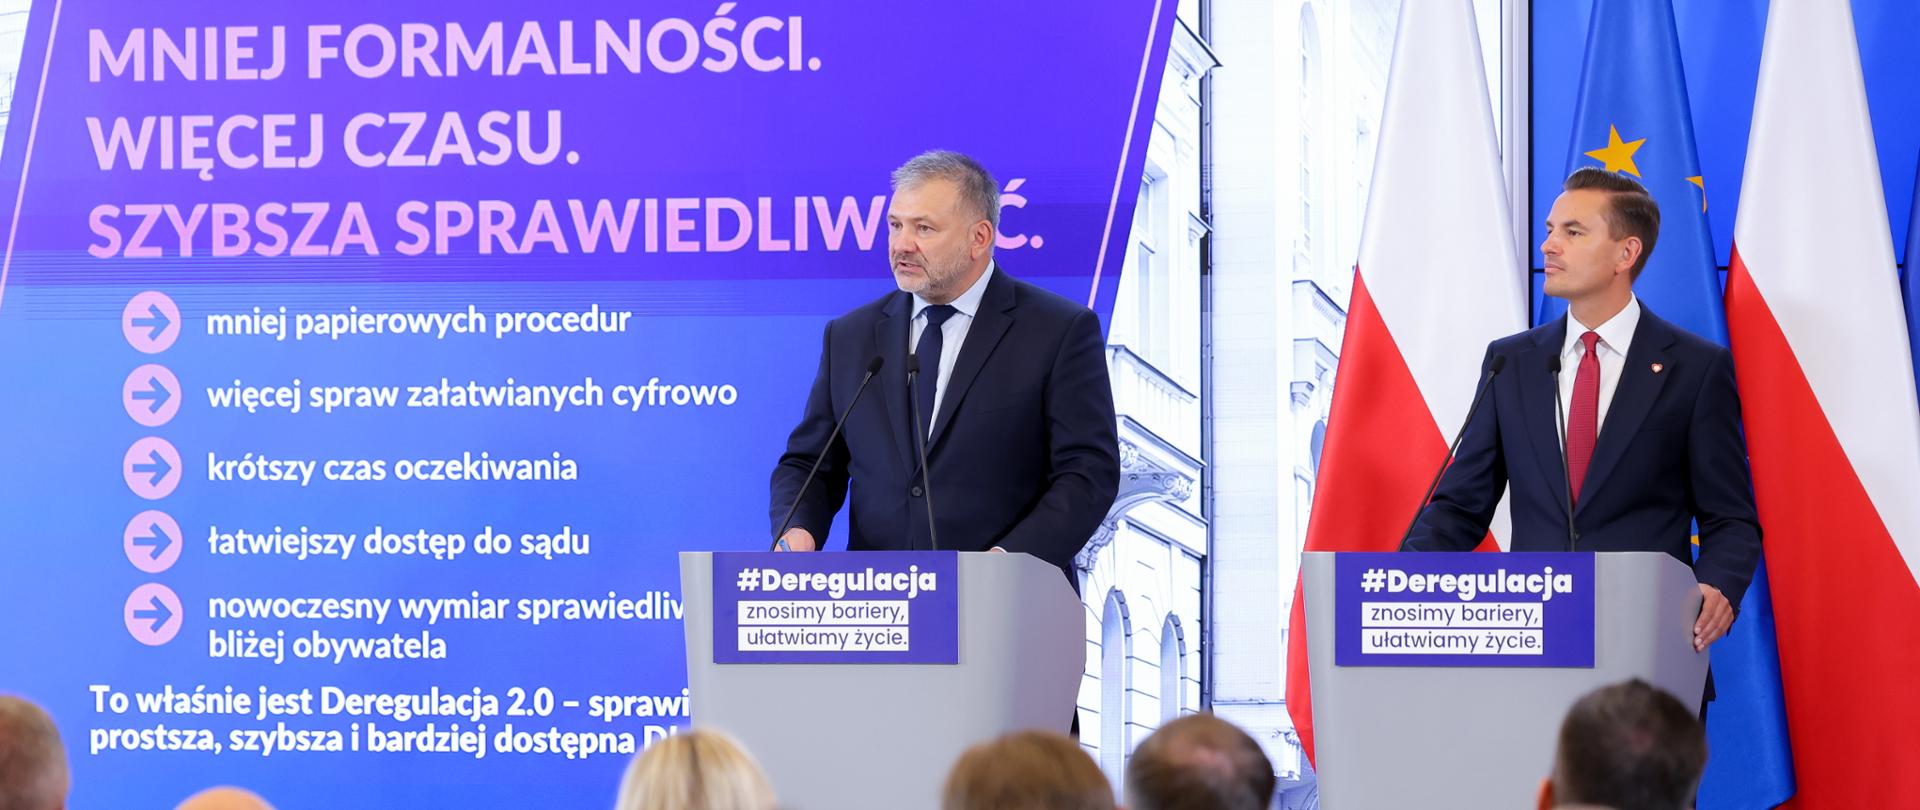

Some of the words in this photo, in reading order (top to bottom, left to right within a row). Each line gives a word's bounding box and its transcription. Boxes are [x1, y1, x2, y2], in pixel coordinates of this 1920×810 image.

[90, 26, 285, 82] MNIEJ
[309, 3, 820, 78] FORMALNOŚCI.
[86, 114, 323, 180] WIĘCEJ
[344, 111, 579, 167] CZASU.
[88, 203, 379, 258] SZYBSZA
[395, 177, 1044, 254] SPRAWIEDLIWĆ.
[208, 307, 286, 340] mniej
[296, 305, 485, 339] papierowych
[496, 304, 631, 338] procedur
[207, 380, 300, 413] więcej
[310, 387, 398, 412] spraw
[408, 378, 602, 411] załatwianych
[613, 378, 736, 411] cyfrowo
[209, 453, 315, 485] krótszy
[324, 460, 385, 480] czas
[395, 452, 576, 480] oczekiwania
[208, 527, 355, 560] łatwiejszy
[364, 527, 465, 559] dostęp
[474, 526, 509, 554] do
[521, 526, 589, 560] sądu
[737, 566, 935, 598] #Deregulacja
[1361, 567, 1571, 600] #Deregulacja
[210, 599, 390, 624] nowoczesny
[399, 591, 509, 624] wymiar
[747, 603, 826, 623] znosimy
[833, 602, 904, 623] bariery,
[1372, 604, 1455, 626] znosimy
[1462, 605, 1537, 626] bariery,
[210, 630, 283, 664] bliżej
[294, 631, 446, 663] obywatela
[748, 629, 848, 650] ułatwiamy
[855, 629, 906, 650] życie.
[1372, 631, 1478, 653] ułatwiamy
[1486, 632, 1540, 653] życie.
[90, 685, 128, 713] To
[136, 685, 251, 714] właśnie
[257, 686, 312, 720] jest
[322, 687, 498, 721] Deregulacja
[507, 688, 553, 716] 2.0
[91, 725, 221, 754] prostsza,
[230, 723, 342, 756] szybsza
[351, 723, 359, 751] i
[368, 723, 485, 758] bardziej
[494, 724, 635, 760] dostępna
